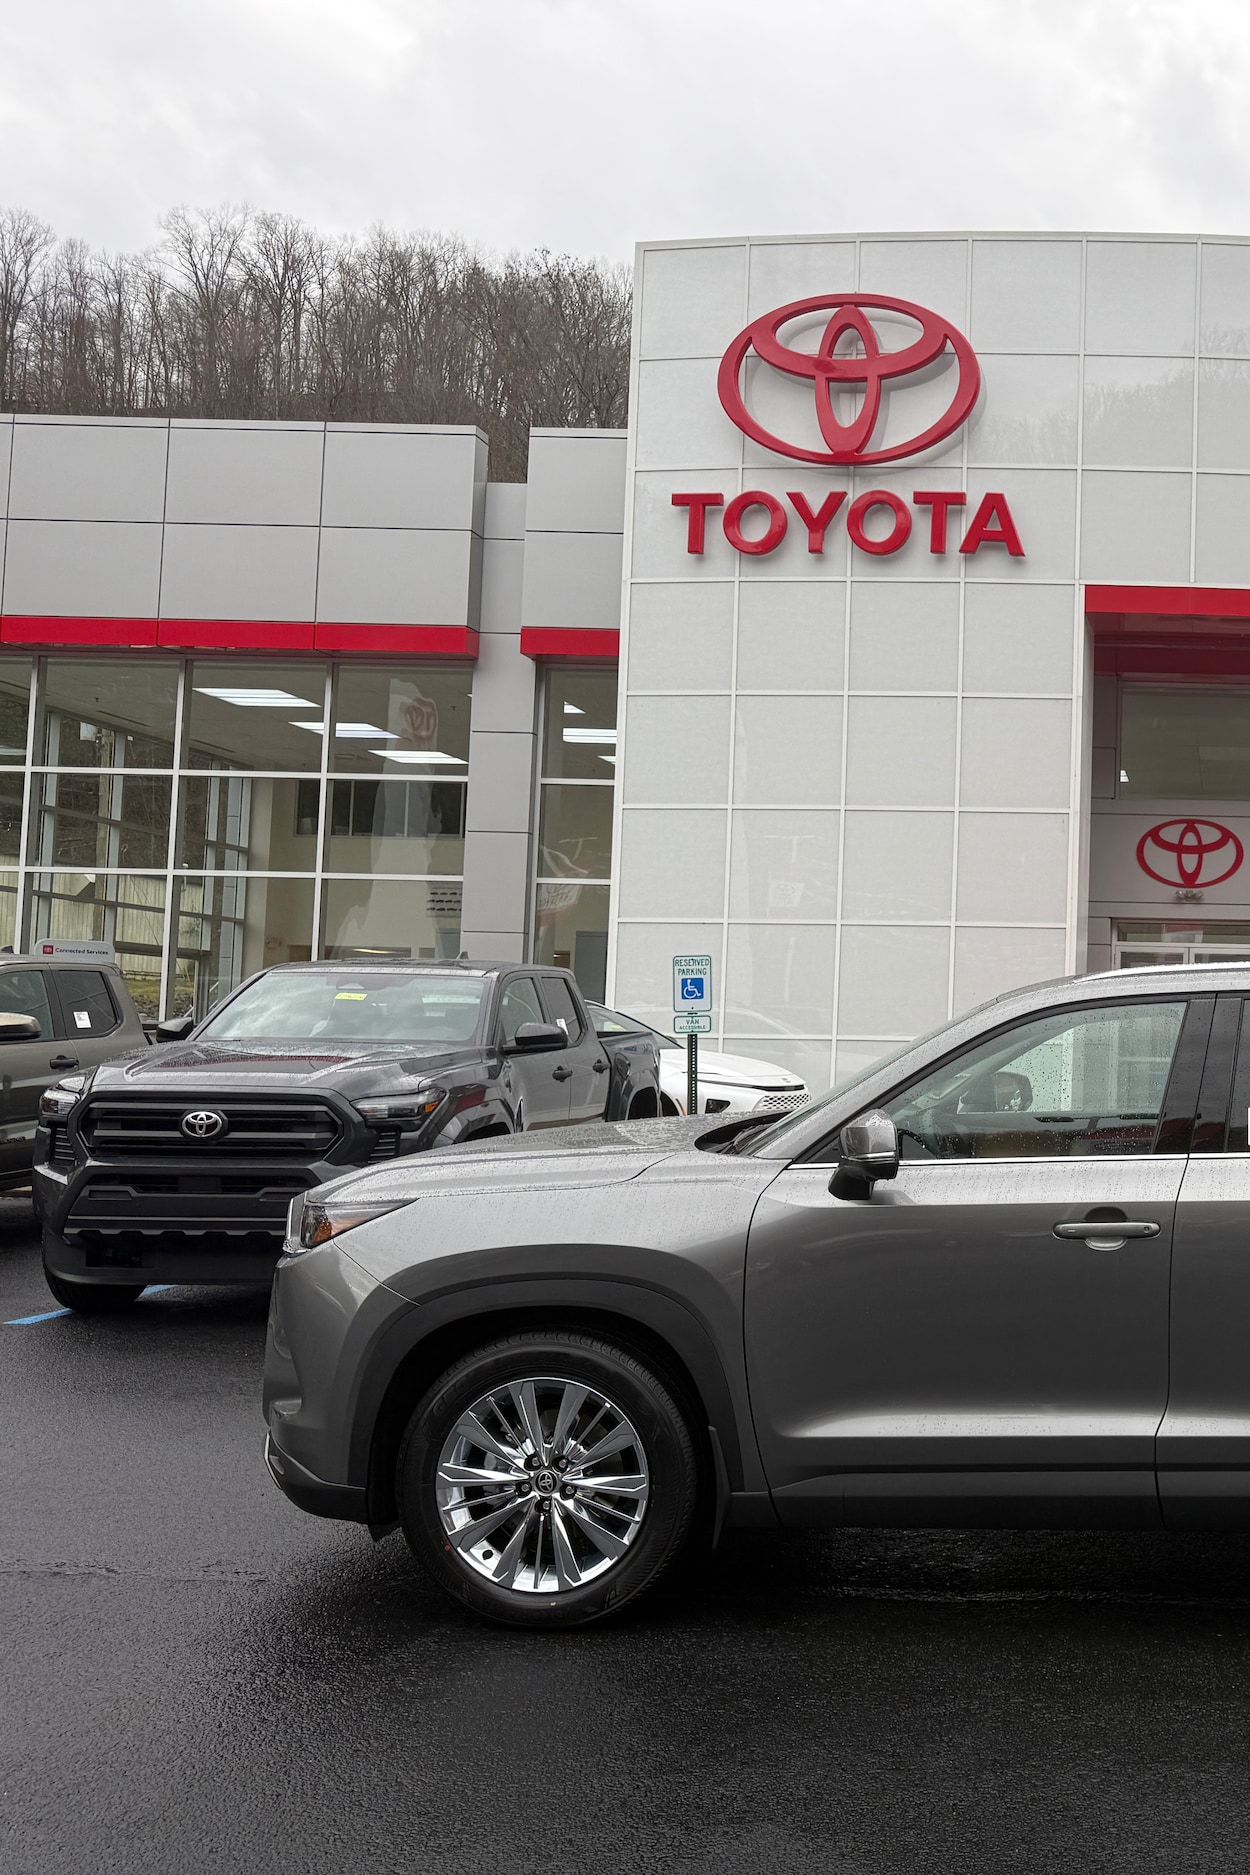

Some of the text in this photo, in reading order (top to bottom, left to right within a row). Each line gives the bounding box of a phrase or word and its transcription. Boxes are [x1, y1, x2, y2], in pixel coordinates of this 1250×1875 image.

[671, 490, 1026, 558] TOYOTA
[674, 958, 710, 966] RESERVED
[678, 968, 707, 976] PARKING
